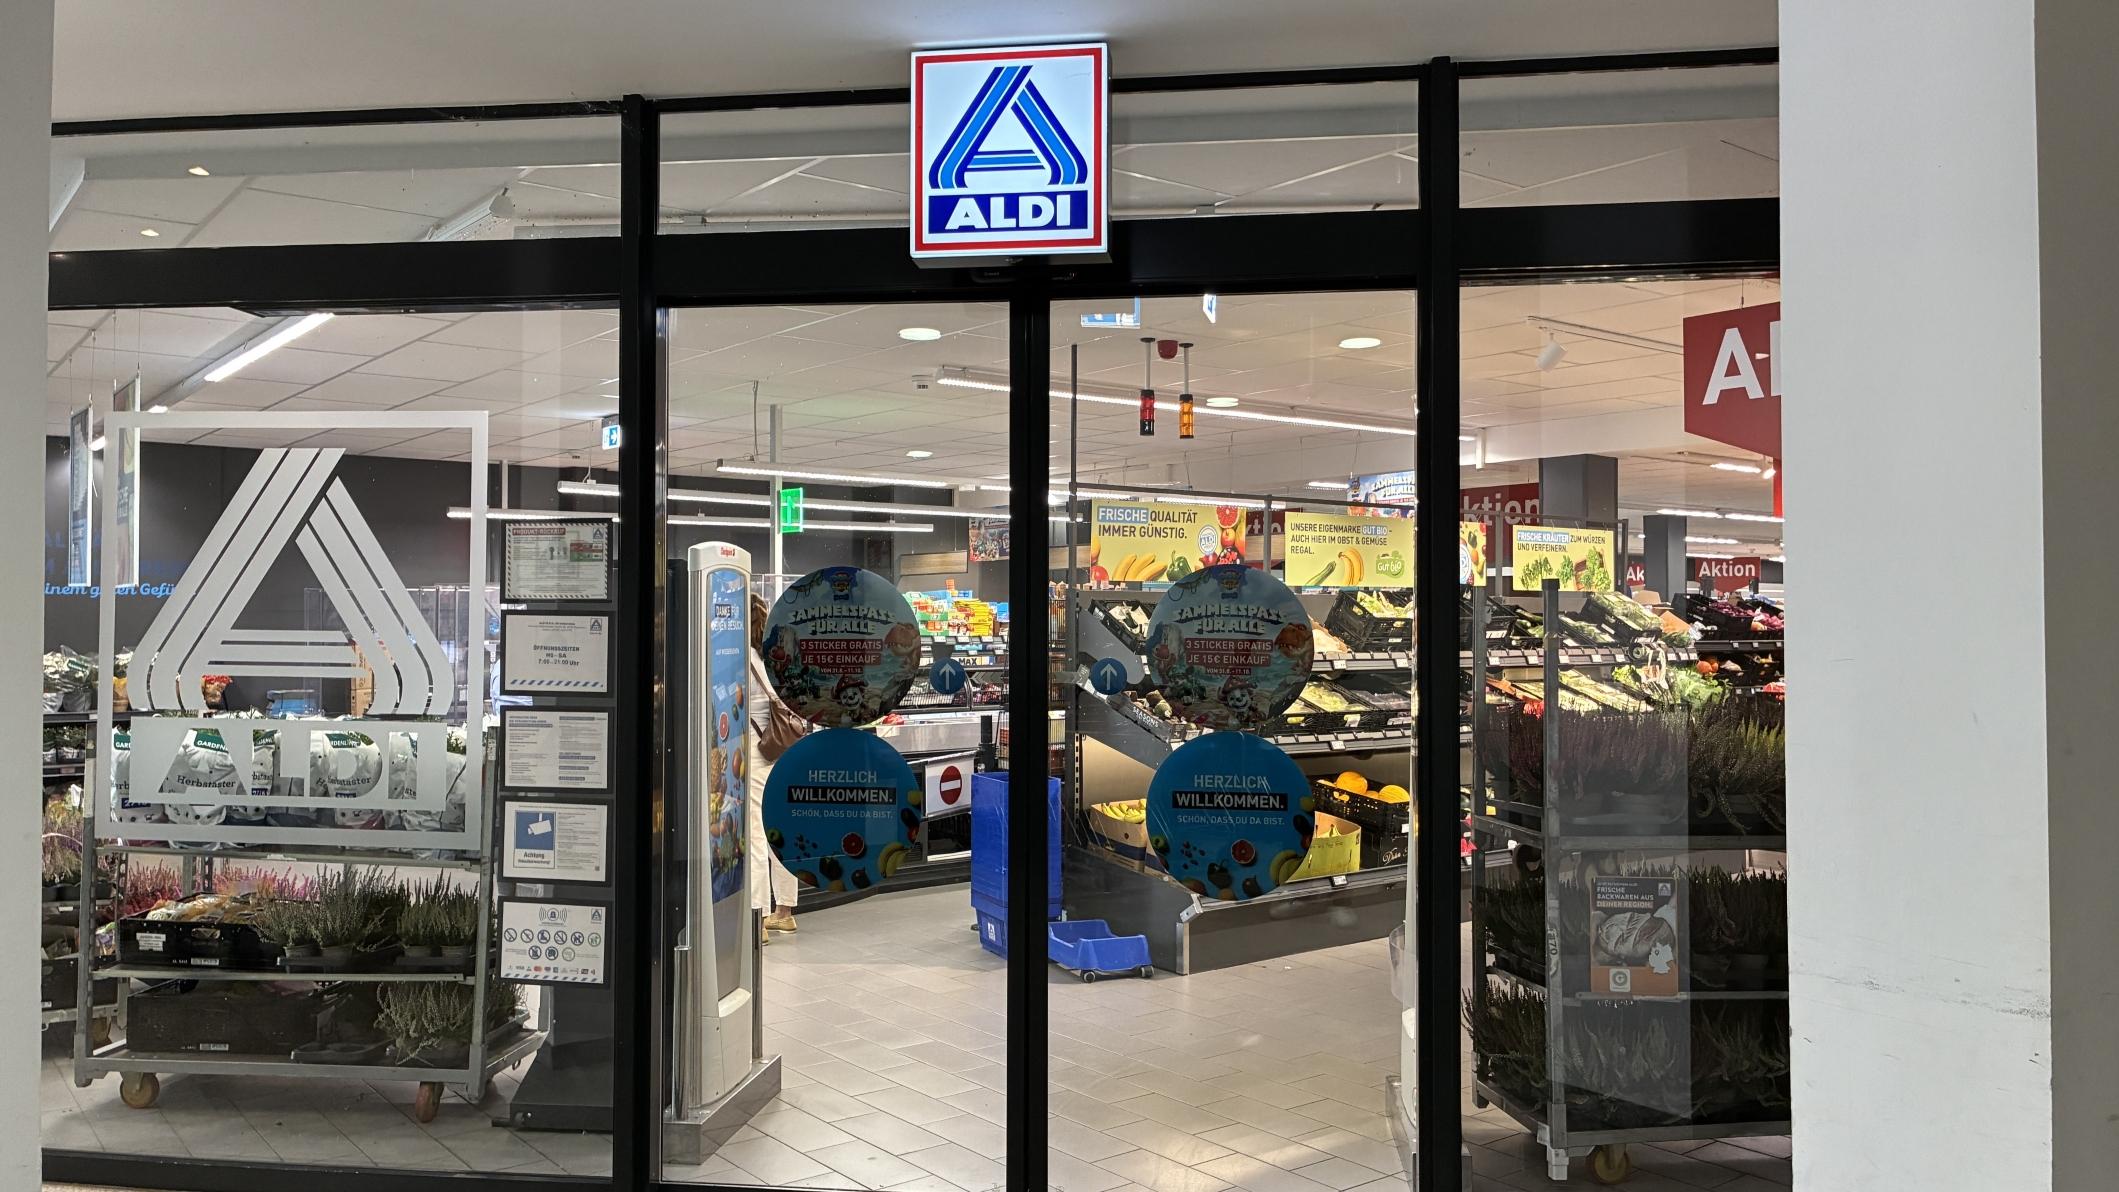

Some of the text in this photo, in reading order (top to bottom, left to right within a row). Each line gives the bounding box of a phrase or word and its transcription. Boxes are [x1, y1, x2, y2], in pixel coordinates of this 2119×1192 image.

[945, 194, 1071, 230] ALDI
[1099, 508, 1198, 524] FRISCHE QUALITÄT
[1463, 493, 1540, 526] ktion
[1098, 524, 1187, 539] IMMER GÜNSTIG.
[1291, 522, 1317, 532] UNSERE
[1319, 523, 1360, 534] EIGENMARKE
[1362, 526, 1376, 534] GUT
[1377, 526, 1387, 535] BIO
[1291, 535, 1388, 545] AUCH HIER IM OBST & GEMÜSE
[1518, 532, 1606, 544] FRISCHE KRÄUTER ZUM WÜRZEN
[1291, 546, 1315, 554] REGAL.
[1518, 543, 1568, 552] UND VERFEINERN.
[1627, 566, 1645, 581] Ak
[1698, 561, 1755, 577] Aktion
[140, 583, 176, 598] Gefü
[788, 605, 896, 621] SAMMELSPASS
[841, 619, 876, 633] ALLE
[801, 641, 882, 650] 3 STICKER GRATIS
[1186, 640, 1272, 650] 3 STICKER GRATIS
[803, 655, 814, 663] JE
[816, 655, 834, 664] 15€
[1188, 654, 1199, 663] JE
[1203, 655, 1221, 664] 15€
[1132, 706, 1158, 728] SEASONS
[197, 740, 228, 751] GARDEN
[158, 727, 418, 800] ALDI
[808, 769, 877, 783] HERZLICH
[1194, 774, 1268, 789] HERZLICH
[791, 787, 893, 803] WILLKOMMEN.
[1176, 793, 1284, 809] WILLKOMMEN.
[824, 810, 845, 818] DASS
[846, 810, 858, 818] DU
[860, 810, 871, 818] DA
[873, 811, 893, 819] BIST.
[1211, 816, 1233, 824] DASS
[1235, 816, 1248, 824] DU
[1250, 816, 1261, 825] DA
[1263, 817, 1285, 825] BIST.
[523, 851, 545, 860] Achtung
